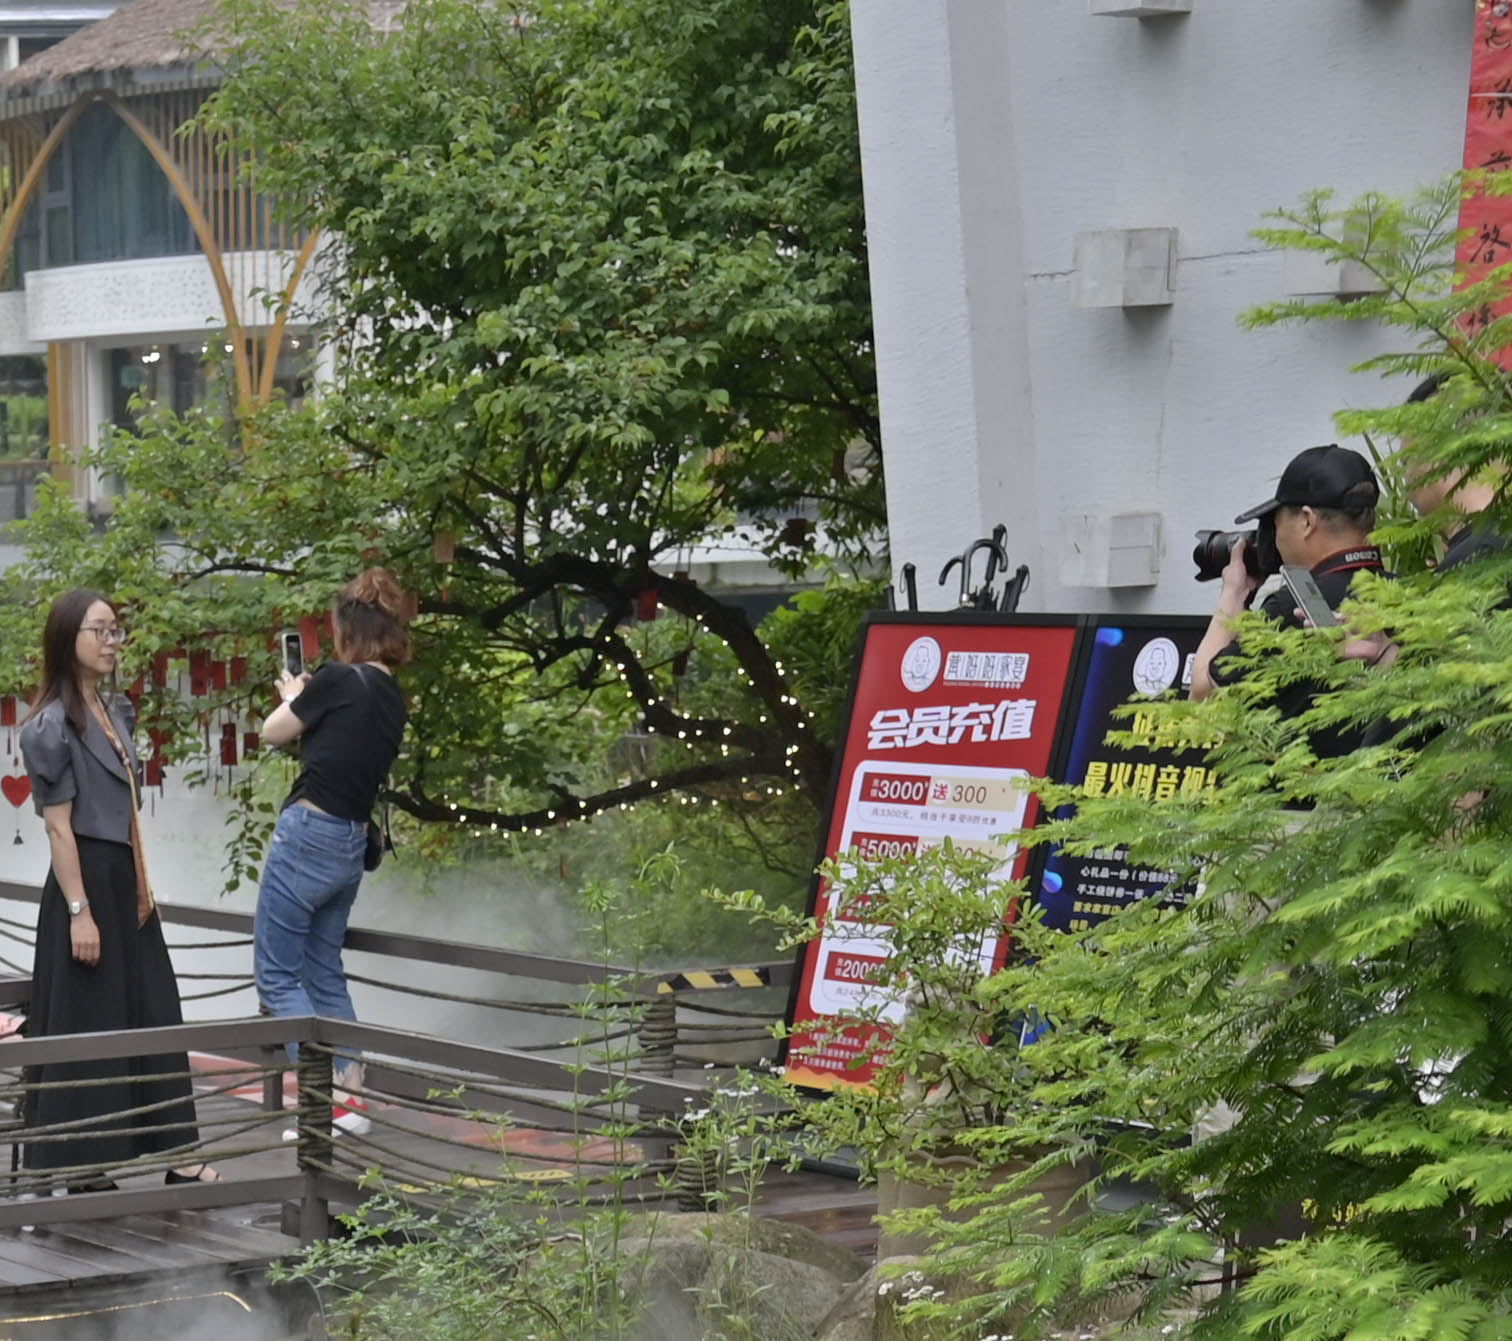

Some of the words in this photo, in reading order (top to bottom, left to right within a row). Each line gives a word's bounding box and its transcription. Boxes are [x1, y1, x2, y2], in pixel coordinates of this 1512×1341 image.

[867, 699, 1037, 750] 会员充值
[878, 780, 924, 800] 3000
[952, 785, 987, 804] 300
